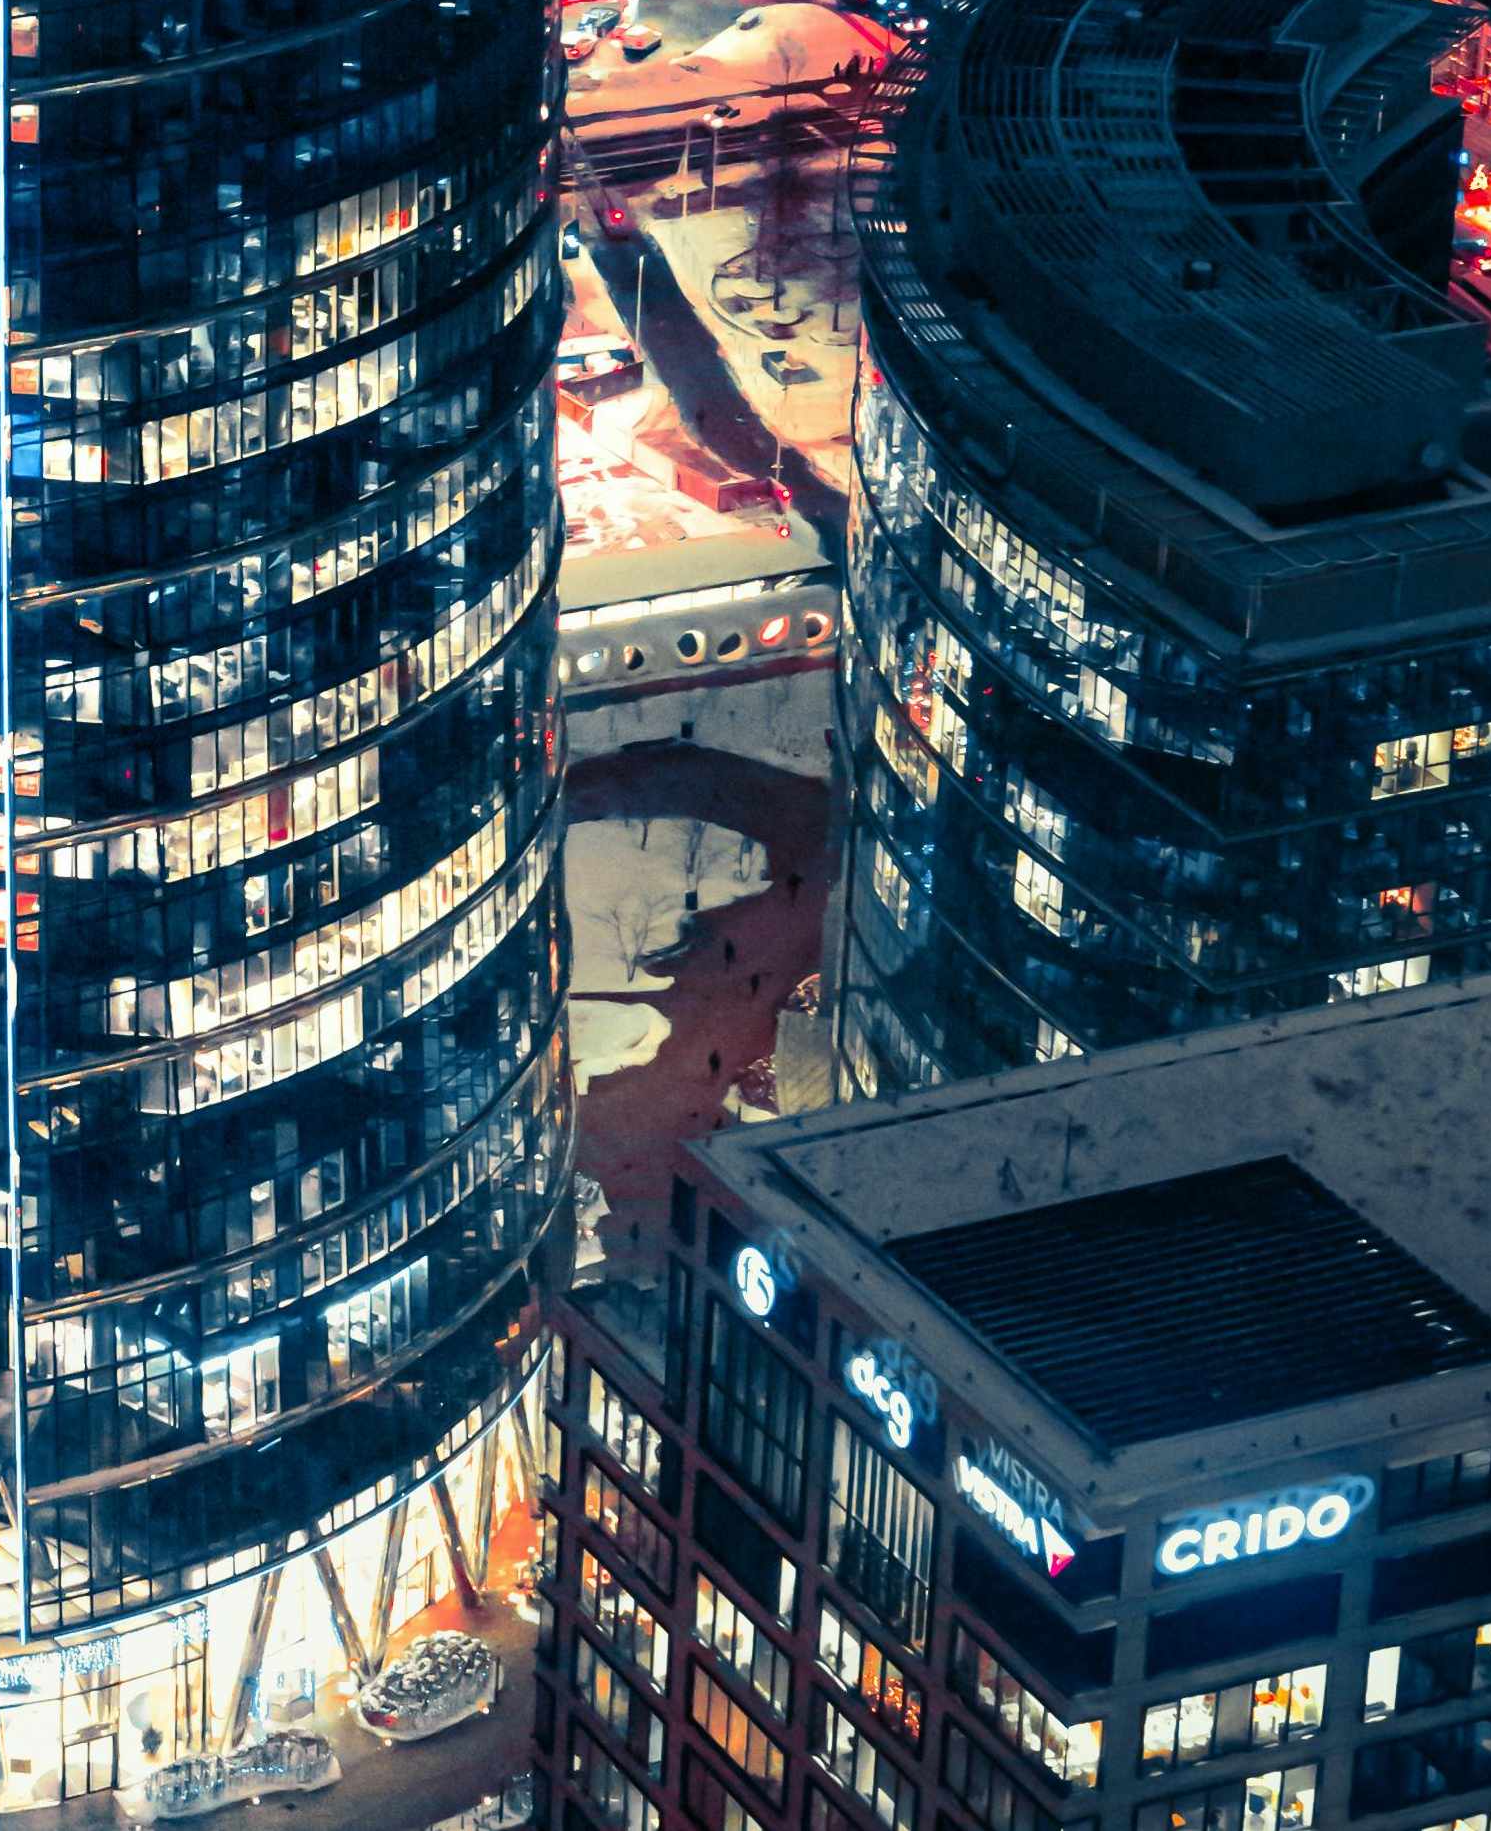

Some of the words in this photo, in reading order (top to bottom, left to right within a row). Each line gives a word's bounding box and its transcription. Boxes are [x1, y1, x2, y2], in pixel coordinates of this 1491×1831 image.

[851, 1350, 913, 1449] dcg
[958, 1455, 1039, 1555] VISTRA
[1160, 1493, 1352, 1574] CRIDO
